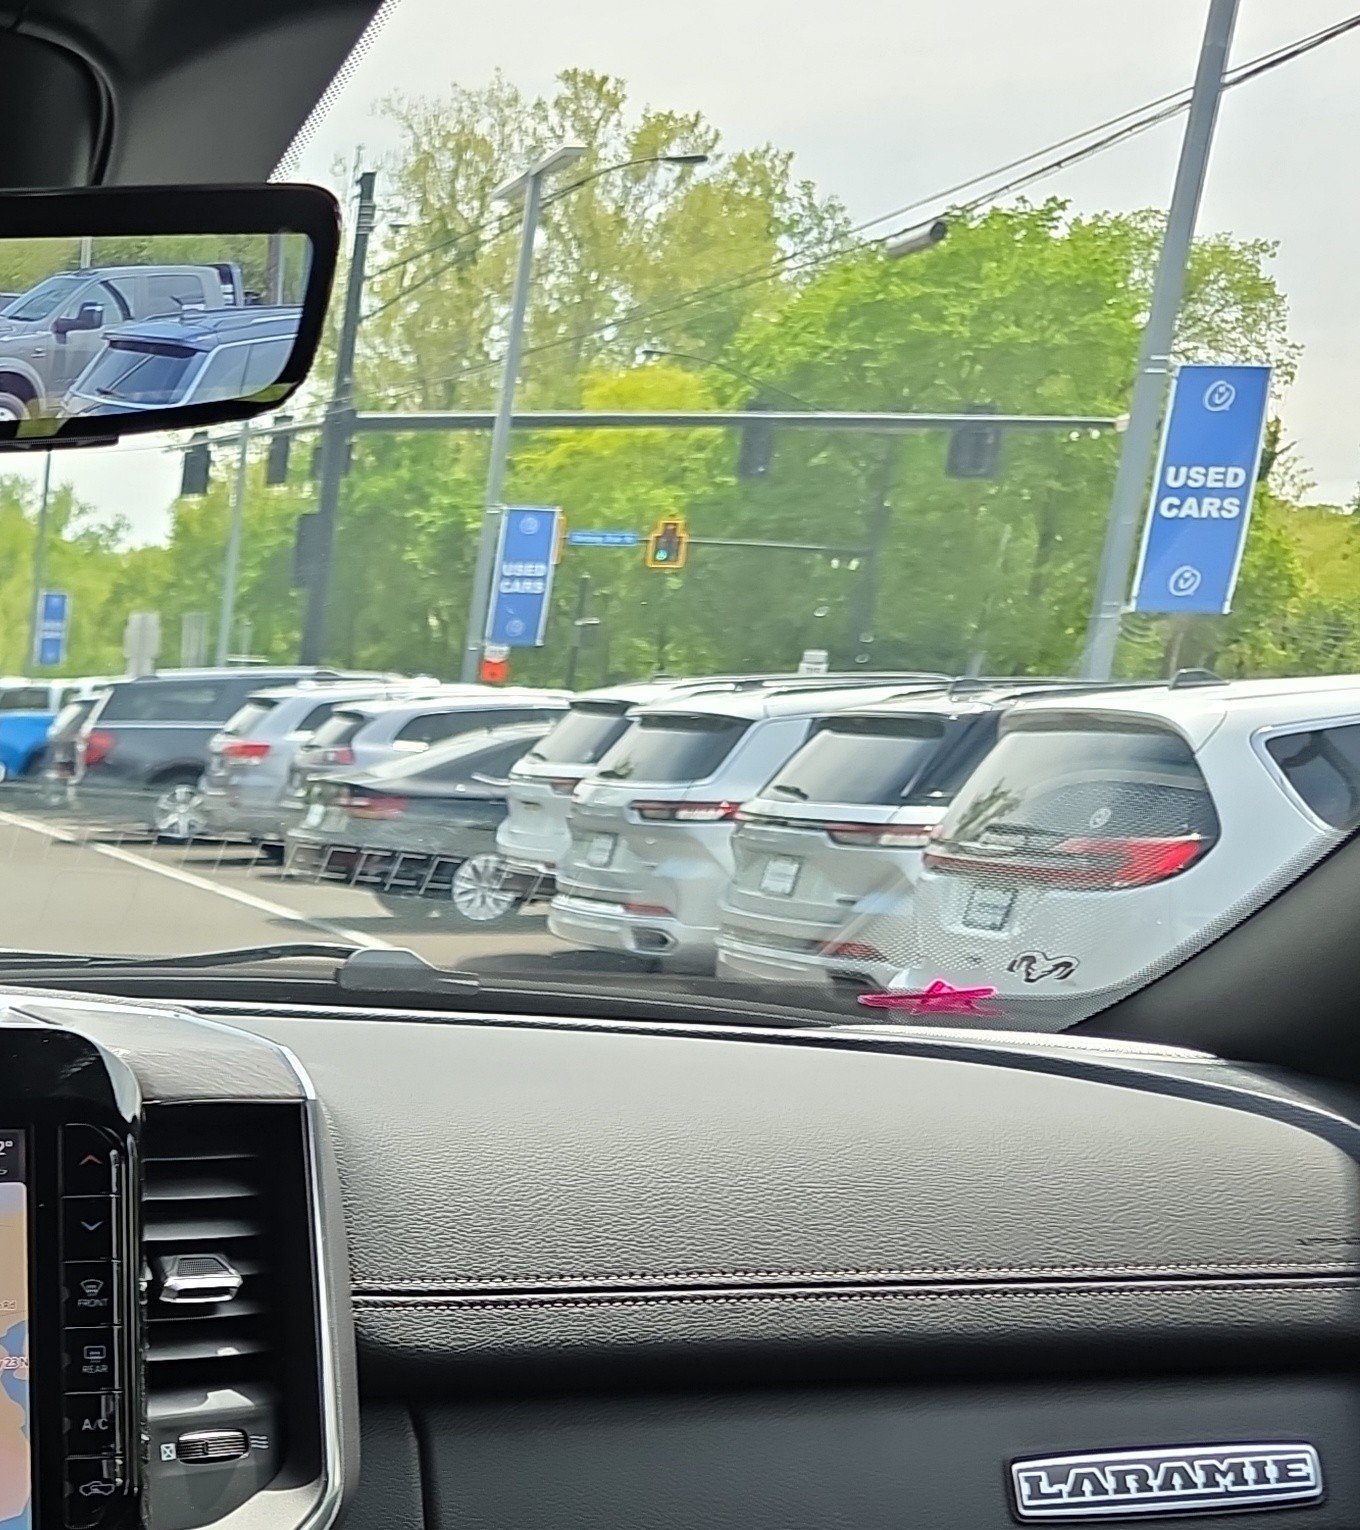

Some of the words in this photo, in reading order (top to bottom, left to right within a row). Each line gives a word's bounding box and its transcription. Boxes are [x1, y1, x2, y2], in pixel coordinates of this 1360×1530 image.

[1165, 466, 1246, 488] USED
[1159, 497, 1240, 519] CARS
[502, 563, 546, 577] USED
[499, 579, 544, 594] CARS
[4, 1357, 19, 1368] 23
[82, 1365, 108, 1373] REAR
[82, 1418, 109, 1431] A/C
[1019, 1453, 1317, 1505] LARAMIE
